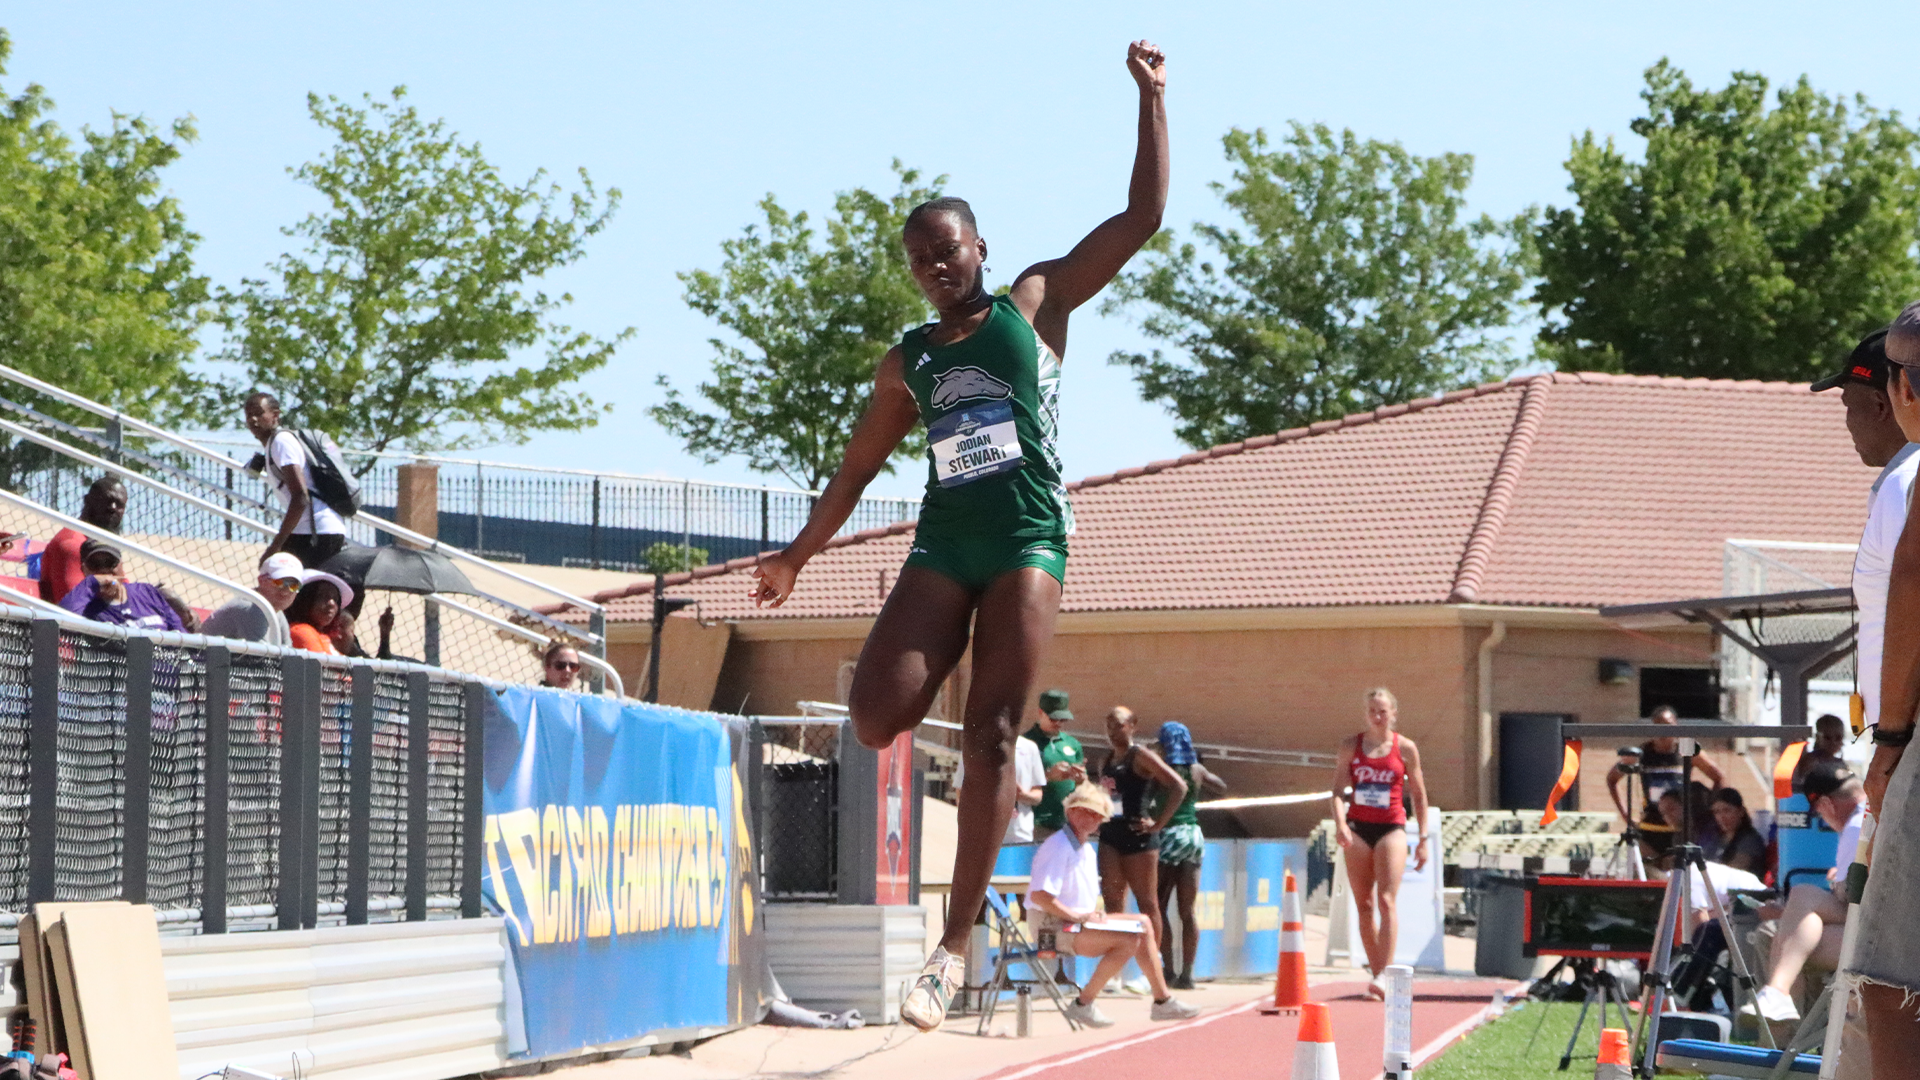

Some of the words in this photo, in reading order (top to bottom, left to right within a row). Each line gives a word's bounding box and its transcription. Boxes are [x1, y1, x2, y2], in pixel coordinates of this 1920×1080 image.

[955, 434, 992, 453] JODIAN
[949, 446, 1007, 473] STEWART
[1354, 766, 1395, 783] Pitt
